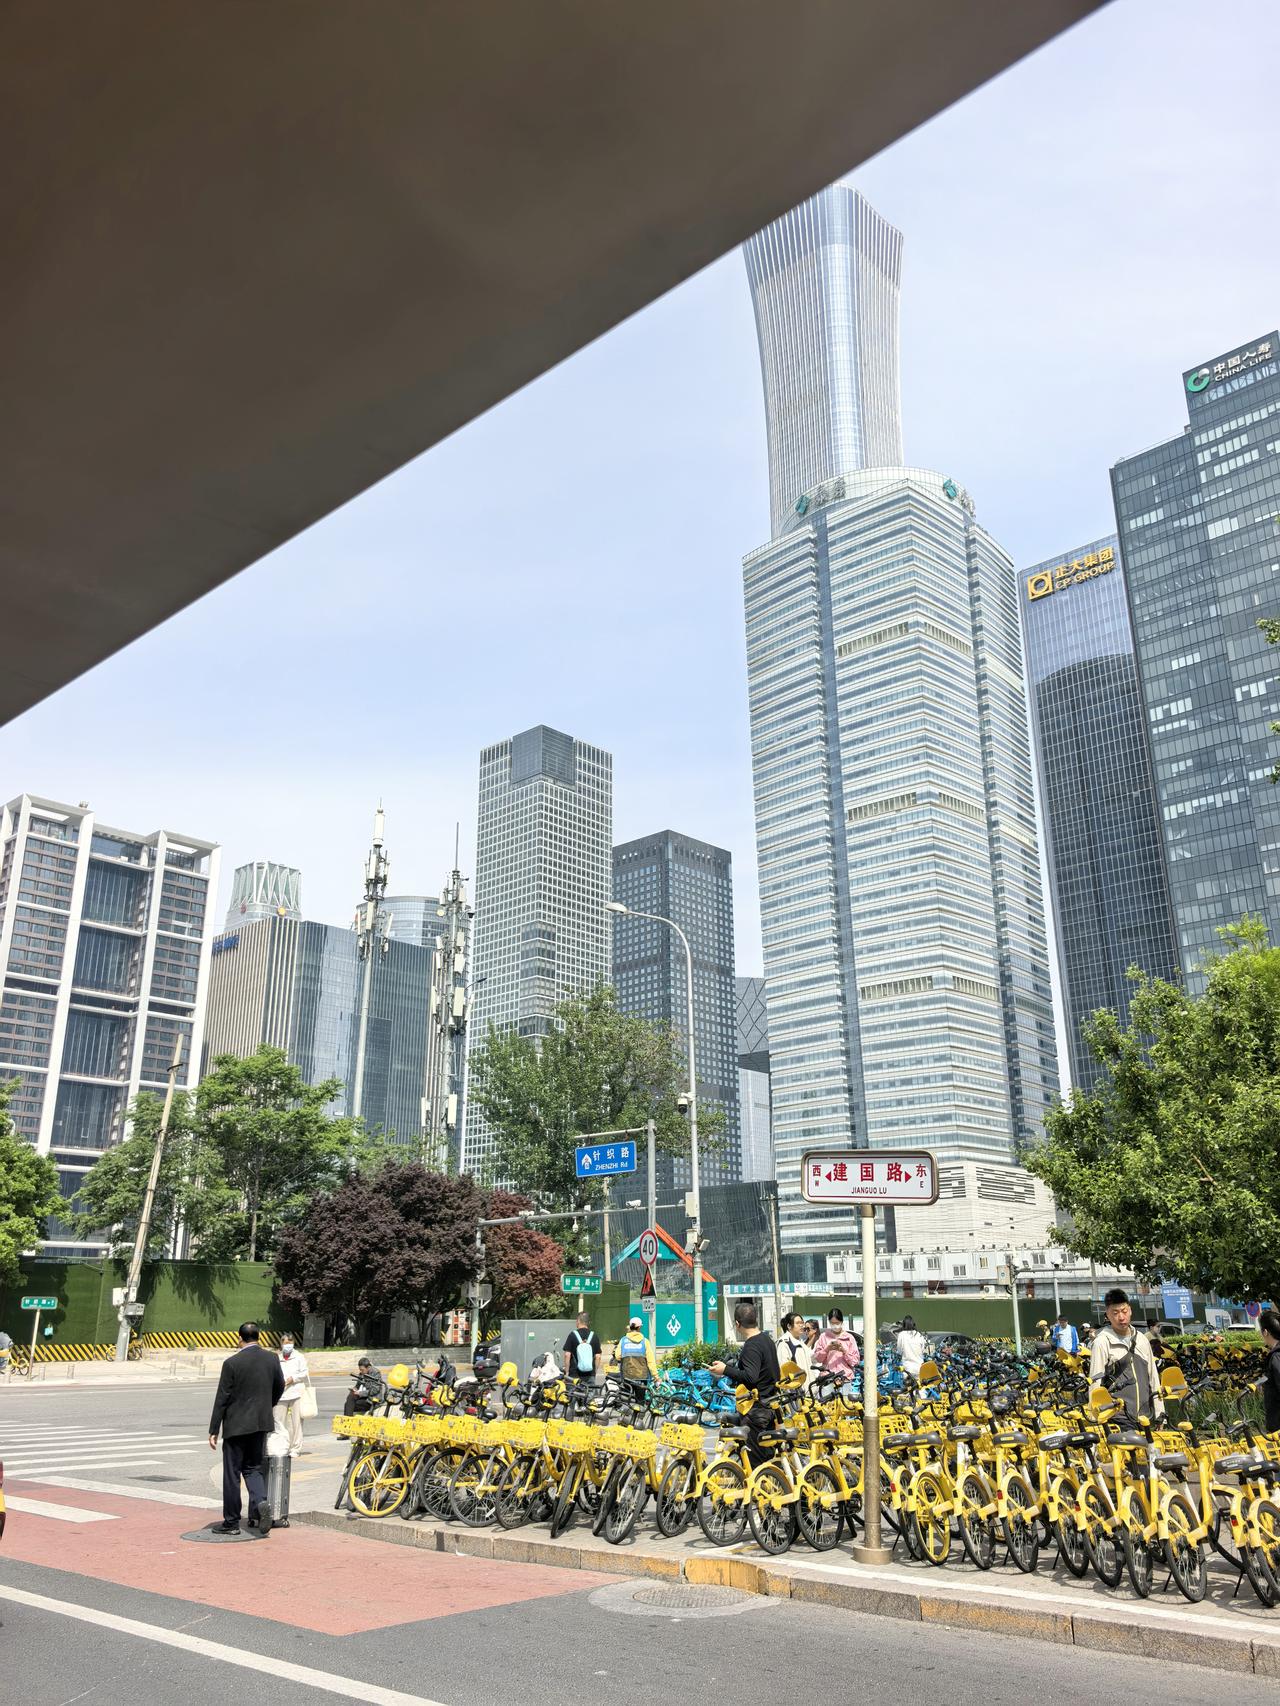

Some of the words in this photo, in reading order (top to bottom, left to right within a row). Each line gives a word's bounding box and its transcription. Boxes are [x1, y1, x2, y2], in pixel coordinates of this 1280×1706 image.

[1213, 342, 1271, 374] 中国人寿
[1215, 364, 1247, 382] CHINA
[1249, 352, 1272, 367] LIFE
[1055, 546, 1114, 579] 正大集团
[1056, 577, 1072, 591] CP
[1073, 561, 1116, 585] GROUP
[592, 1147, 630, 1161] 针织路
[595, 1162, 618, 1171] ZHENZHI
[812, 1164, 821, 1177] 西
[833, 1162, 903, 1182] 建国路
[915, 1164, 927, 1178] 东
[851, 1186, 877, 1194] JIANGUO
[919, 1180, 924, 1188] E
[642, 1239, 654, 1256] 40
